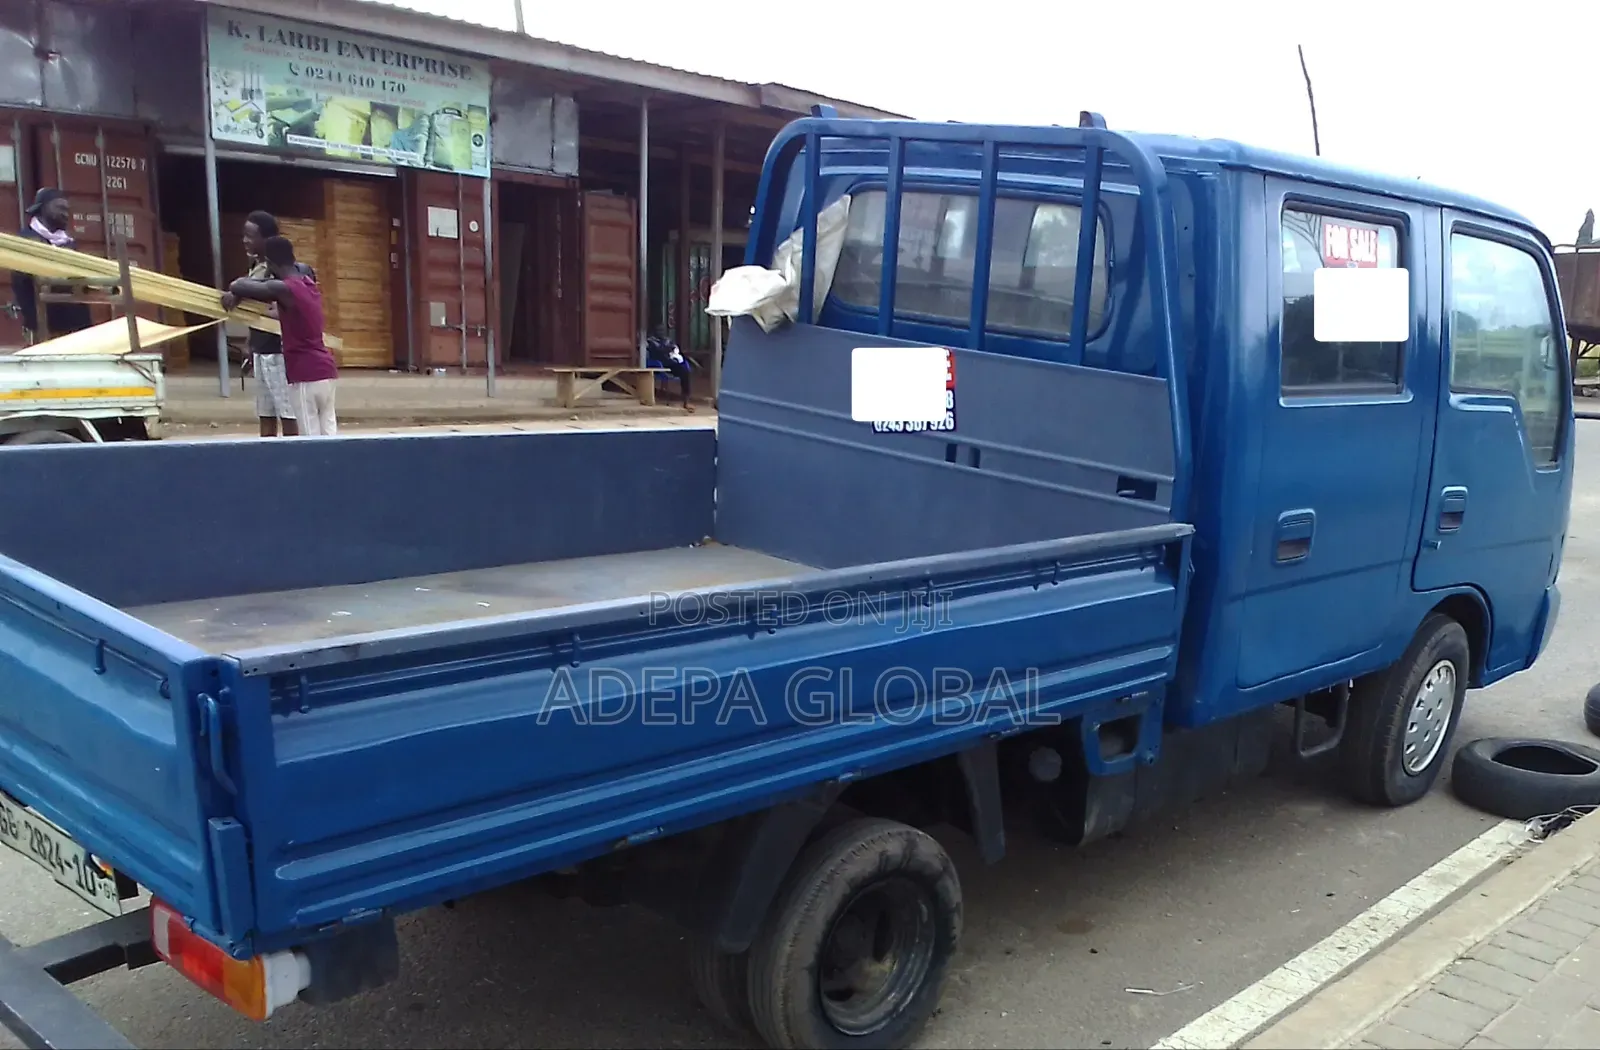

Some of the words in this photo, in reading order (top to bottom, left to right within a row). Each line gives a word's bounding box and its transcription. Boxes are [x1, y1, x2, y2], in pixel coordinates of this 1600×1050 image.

[227, 20, 250, 39] K.
[258, 25, 329, 53] LARBI
[337, 39, 472, 80] ENTERPRISE
[1325, 223, 1349, 260] FOR
